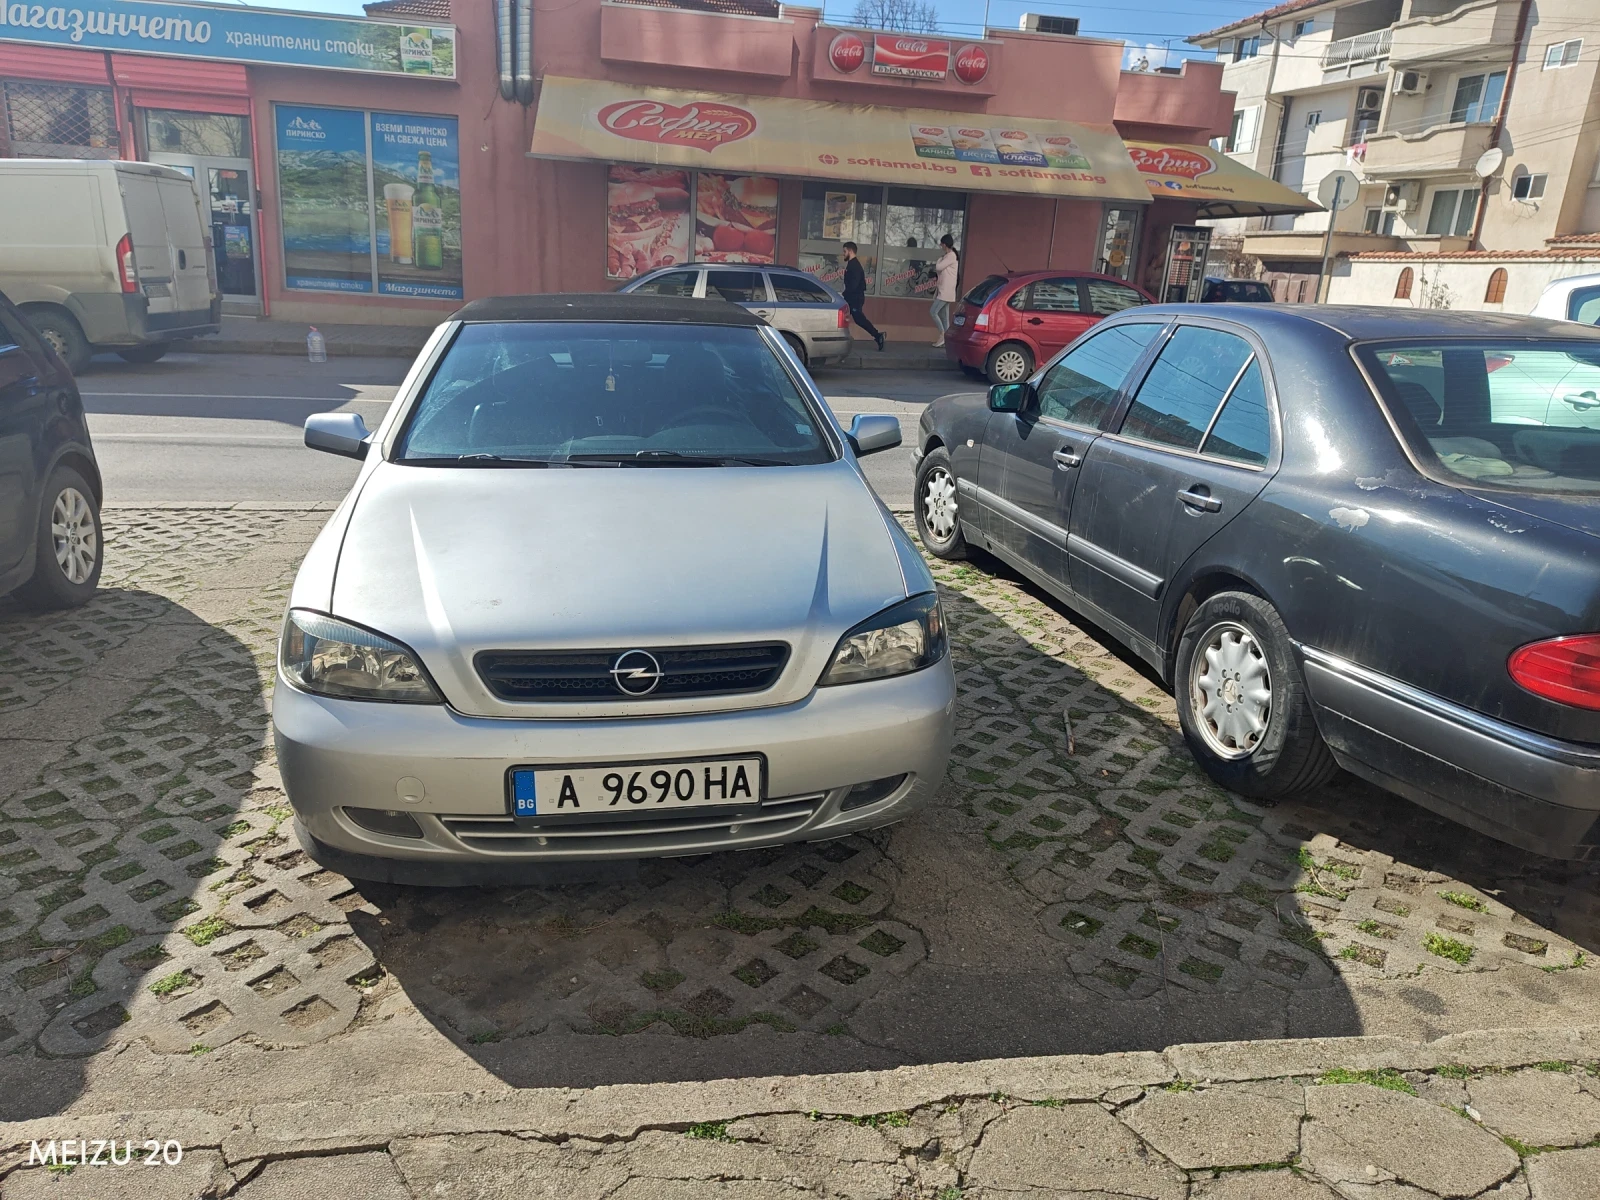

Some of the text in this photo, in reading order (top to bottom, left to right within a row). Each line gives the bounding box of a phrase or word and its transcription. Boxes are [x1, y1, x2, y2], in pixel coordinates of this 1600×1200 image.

[225, 31, 374, 56] хранителни стоки
[877, 67, 940, 78] БЪРЗА ЗАКУСКА
[606, 102, 742, 139] София
[286, 129, 327, 139] ПИРИНСКО
[375, 122, 448, 137] ВЗЕМИ ПИРИНСКО
[673, 130, 723, 142] МЕЛ
[384, 133, 448, 147] НА СВЕЖА ЦЕНА
[919, 147, 956, 156] БАНИЦА
[962, 151, 996, 159] ЕКСТРА
[1003, 154, 1043, 163] КЛАСИК
[847, 157, 957, 174] sofiamel.bg
[998, 169, 1106, 186] sofiamel.bg
[341, 281, 364, 290] стоки
[385, 283, 457, 296] Магазинчето
[1212, 600, 1241, 616] apollo
[557, 775, 581, 809] A
[602, 768, 695, 806] 9690
[517, 800, 535, 809] BG
